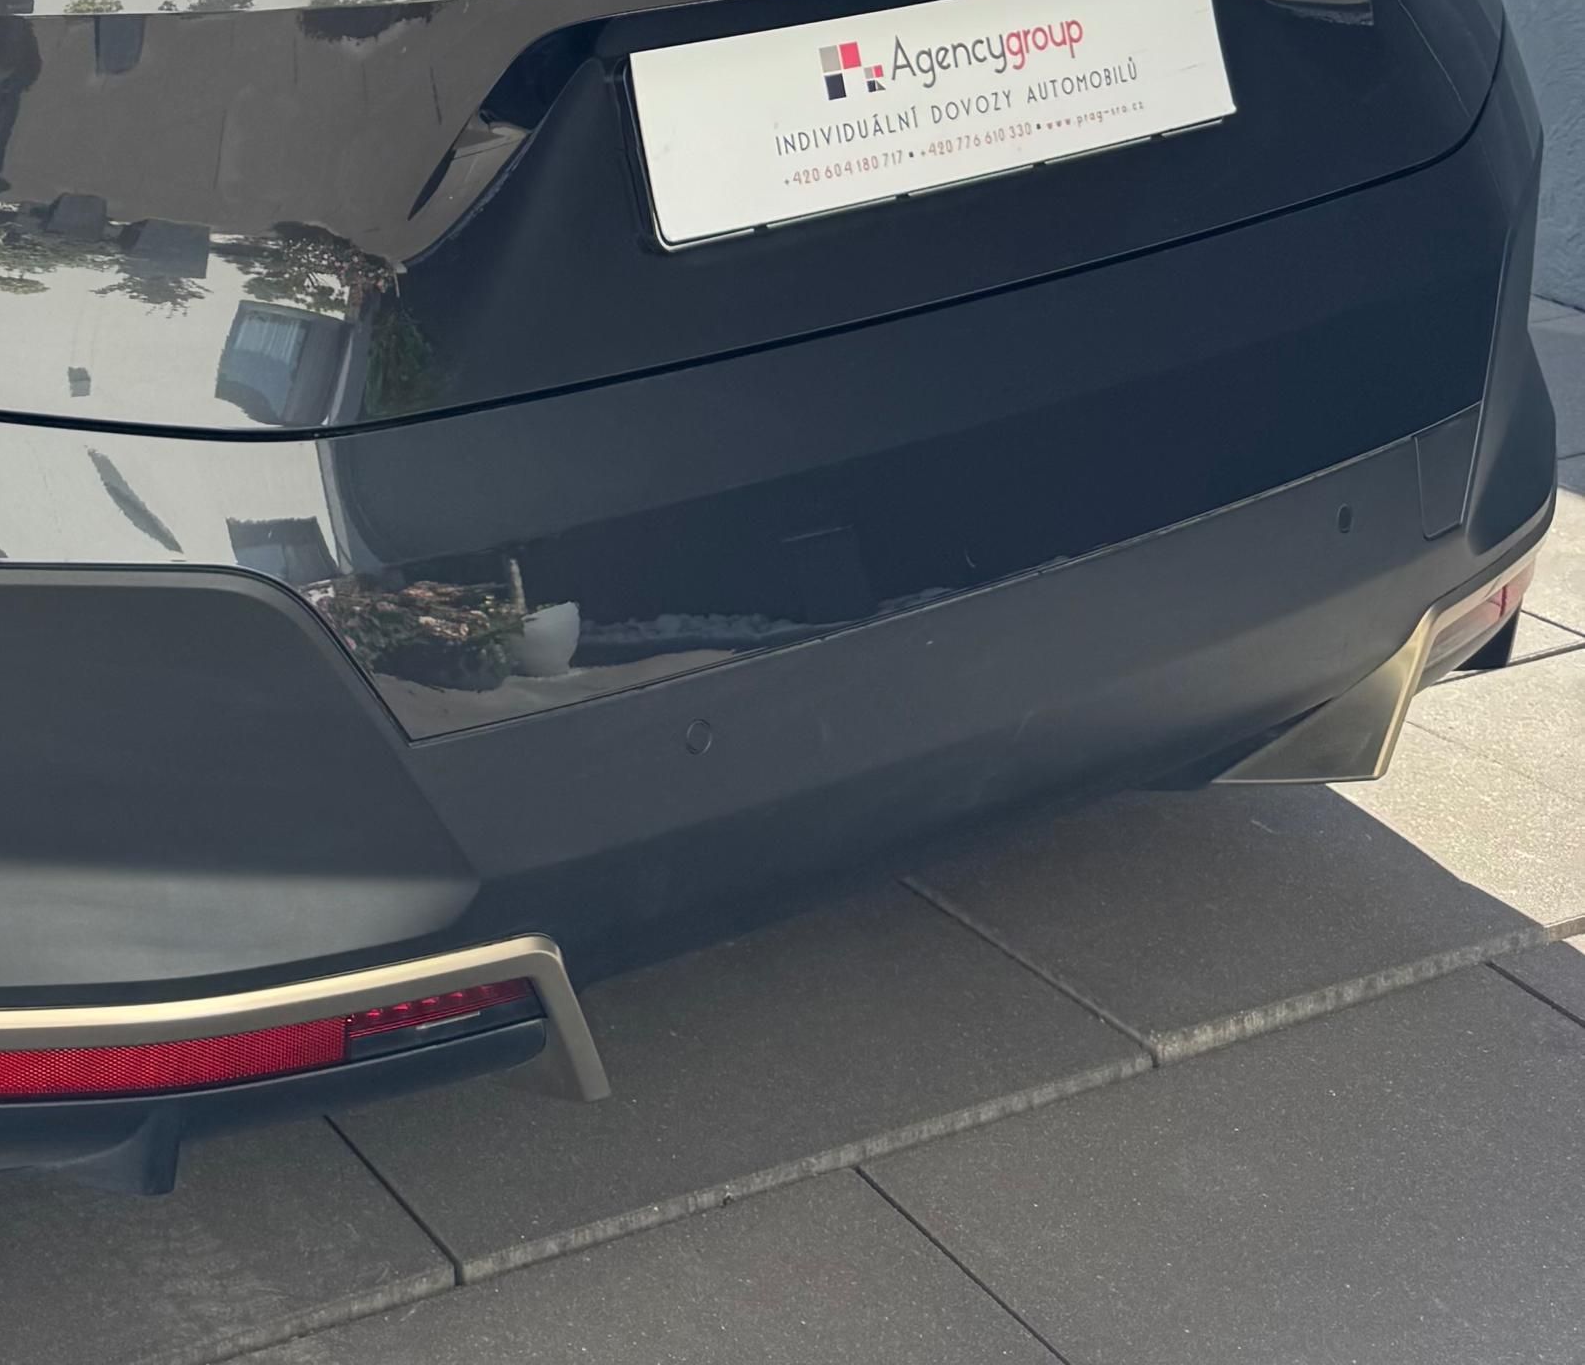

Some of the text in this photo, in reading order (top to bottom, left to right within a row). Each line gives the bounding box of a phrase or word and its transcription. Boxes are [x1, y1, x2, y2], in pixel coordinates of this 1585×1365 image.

[890, 19, 1084, 89] Agencygroup
[774, 55, 1139, 157] INDIVIDUÁLNÍ DOVOZY AUTOMOBILŮ
[824, 161, 854, 179] 604
[856, 154, 880, 173] 180
[881, 149, 903, 168] 717
[956, 134, 982, 150] 776
[984, 127, 1005, 145] 610
[1008, 121, 1033, 139] 330
